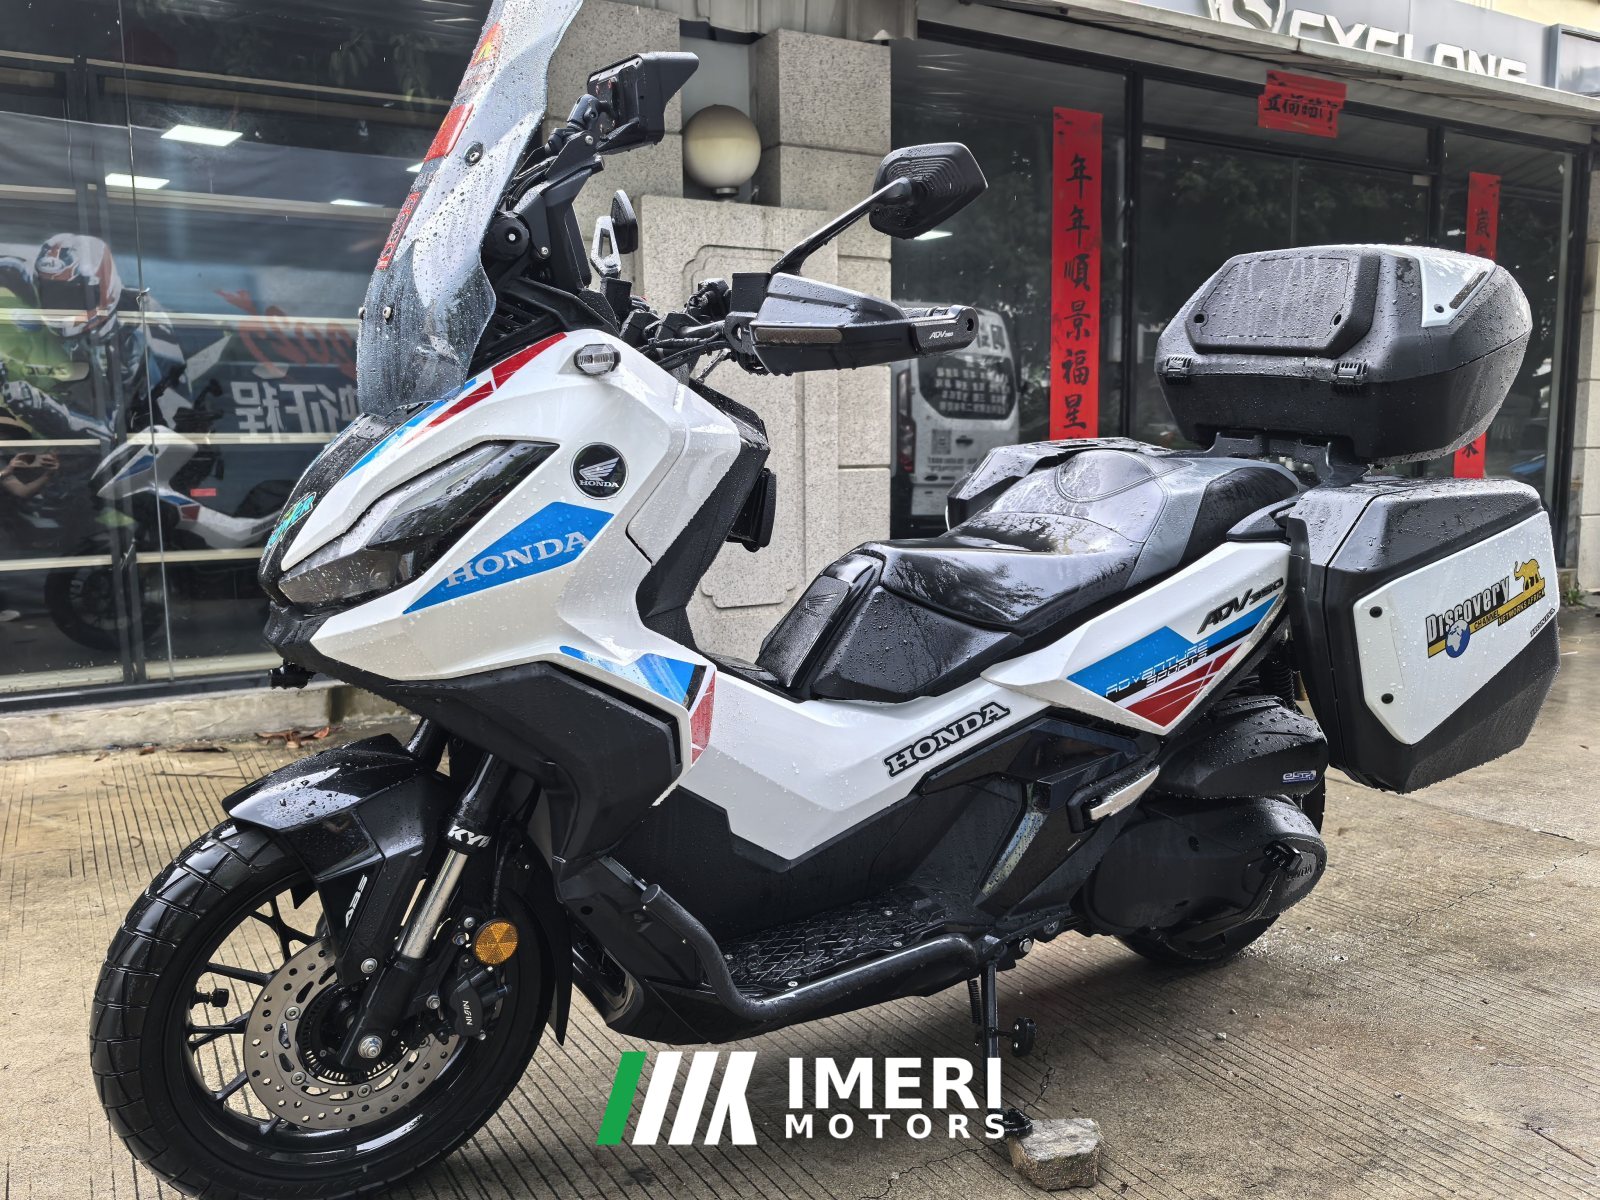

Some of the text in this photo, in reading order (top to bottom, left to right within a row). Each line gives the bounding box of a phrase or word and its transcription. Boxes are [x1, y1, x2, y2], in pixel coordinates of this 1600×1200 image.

[1061, 153, 1092, 438] 年年順景福星
[579, 479, 619, 488] HONDA
[446, 531, 591, 588] HONDA
[1196, 577, 1284, 635] ADV350
[1425, 576, 1510, 644] Discovery
[884, 701, 1010, 777] HONDA
